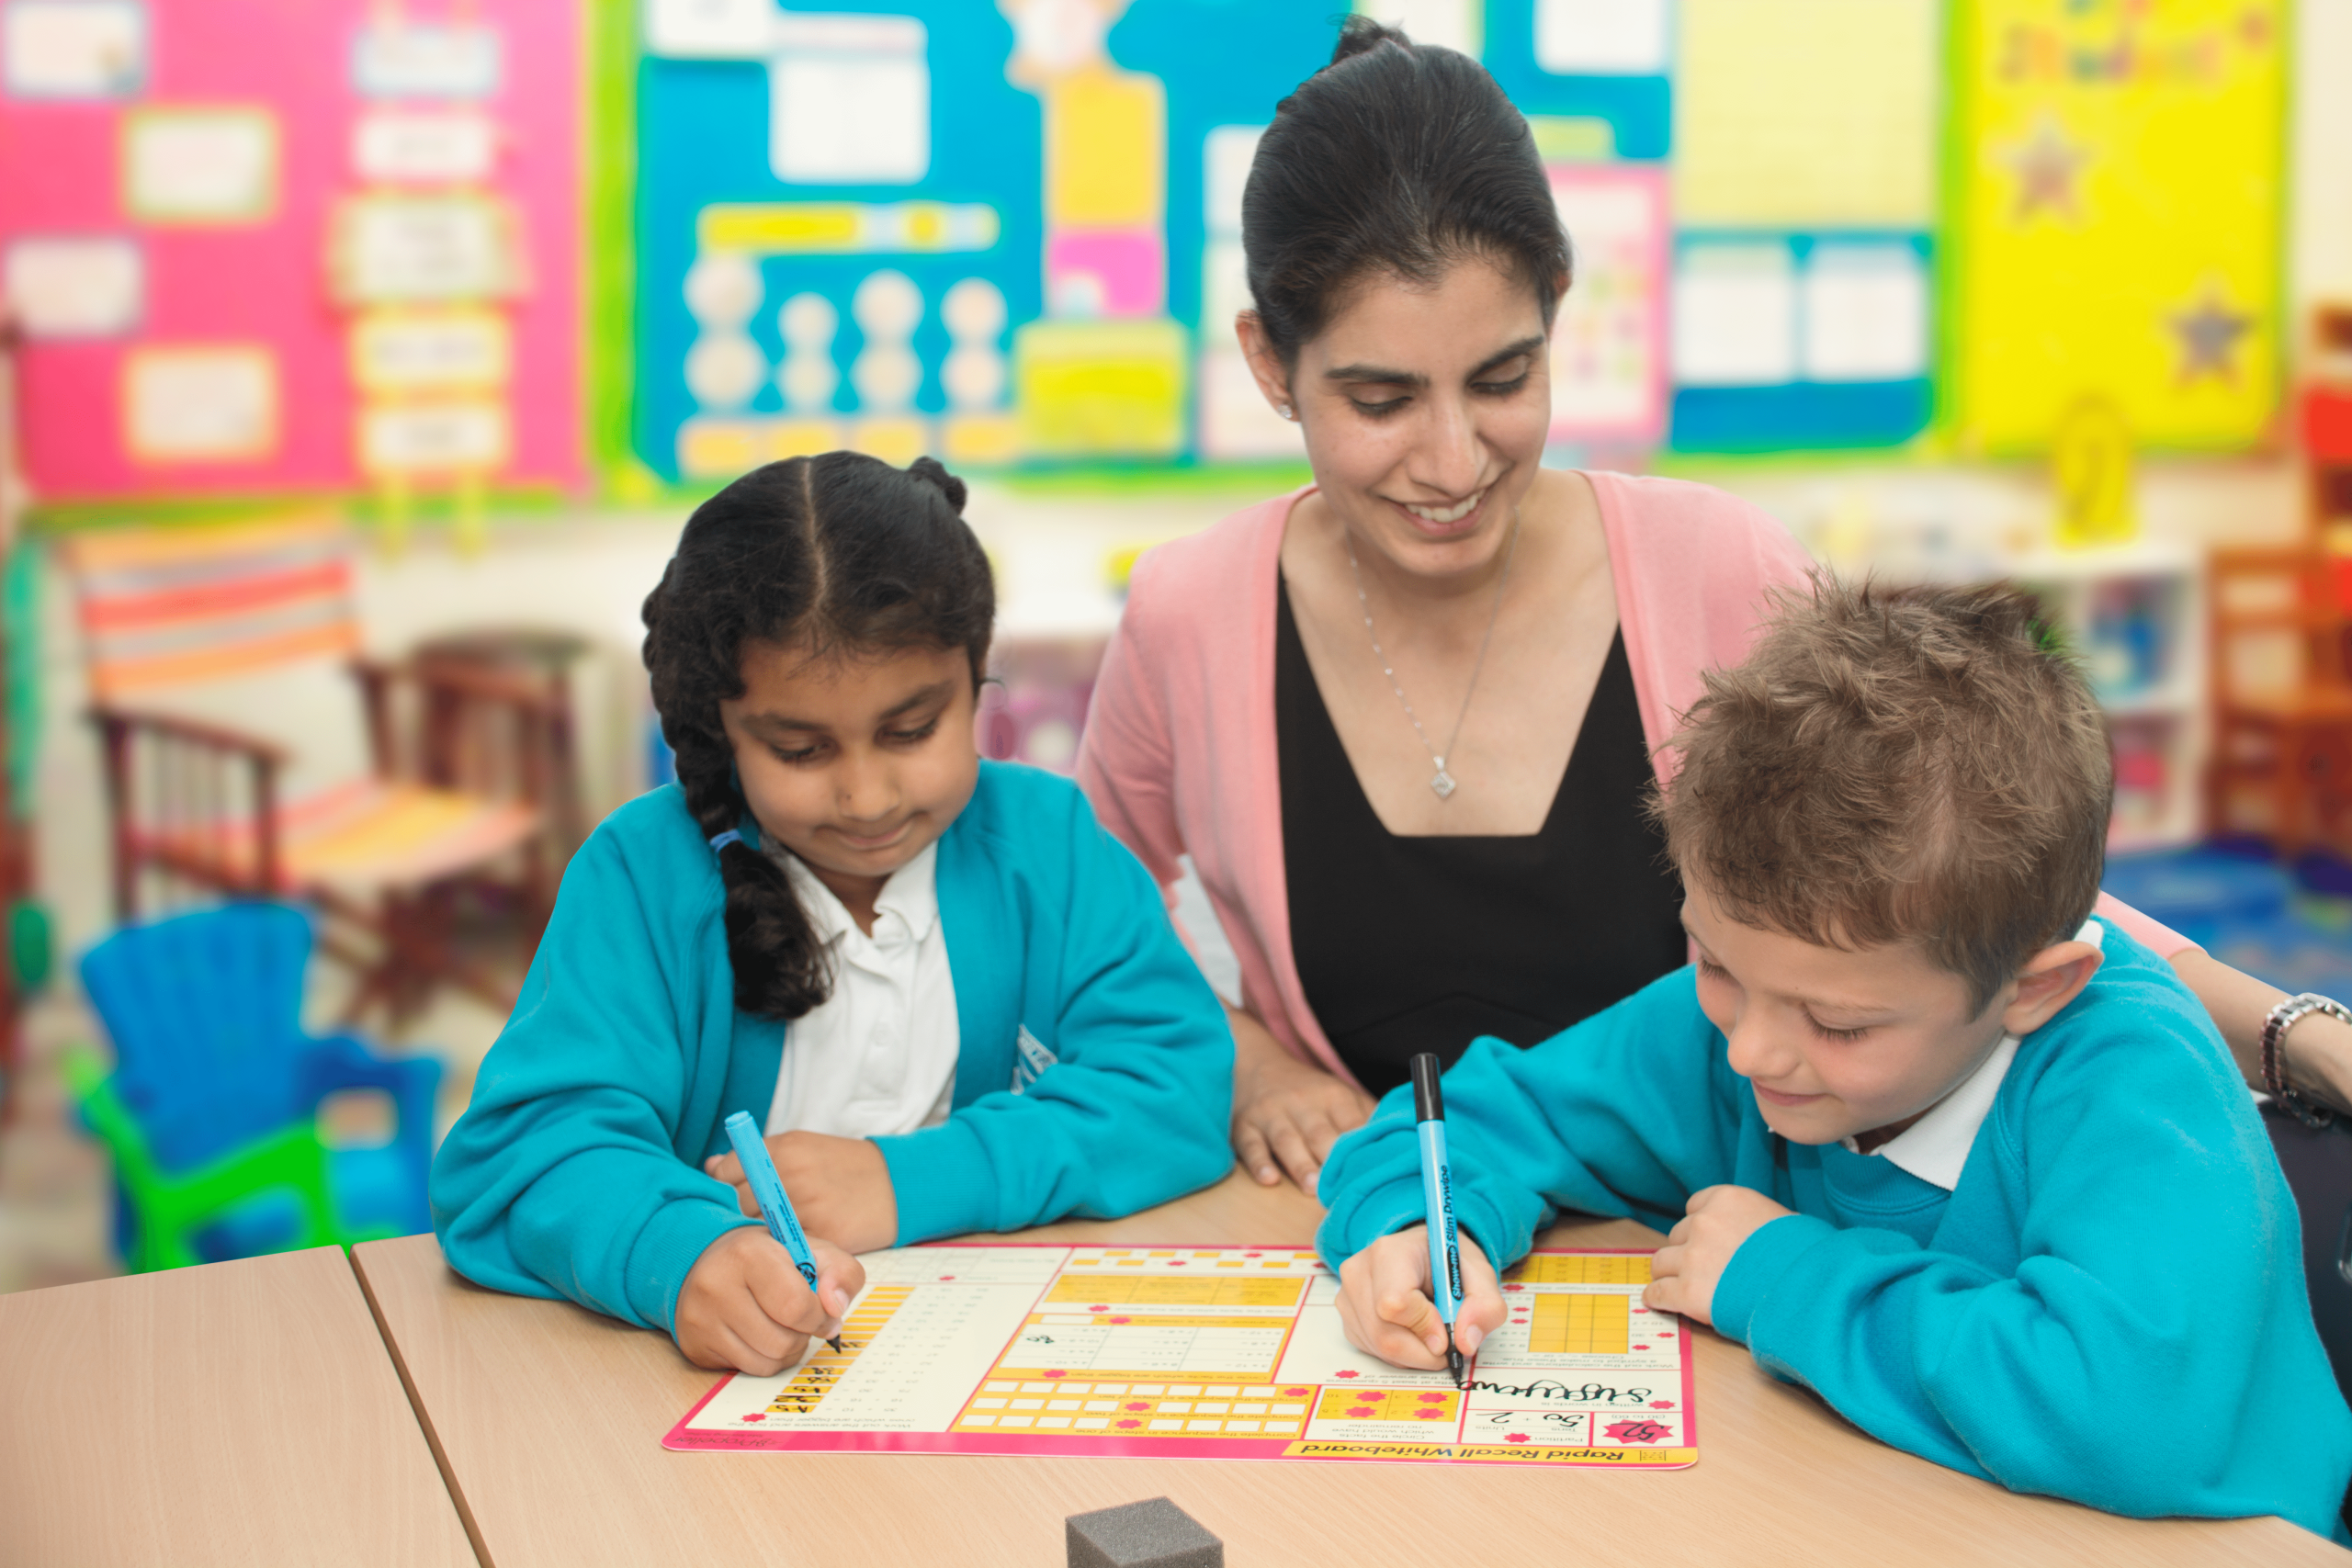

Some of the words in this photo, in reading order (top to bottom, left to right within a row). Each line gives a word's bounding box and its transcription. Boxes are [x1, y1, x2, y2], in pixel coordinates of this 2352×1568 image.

[1441, 1165, 1452, 1213] Drywipe
[1446, 1217, 1455, 1242] Slim
[1449, 1247, 1461, 1297] Show-me
[1476, 1412, 1513, 1424] 2
[1543, 1414, 1584, 1427] 50
[1611, 1423, 1665, 1441] 52
[1300, 1446, 1452, 1457] Whiteboard
[1460, 1449, 1539, 1459] Recall
[1545, 1450, 1624, 1461] Rapid
